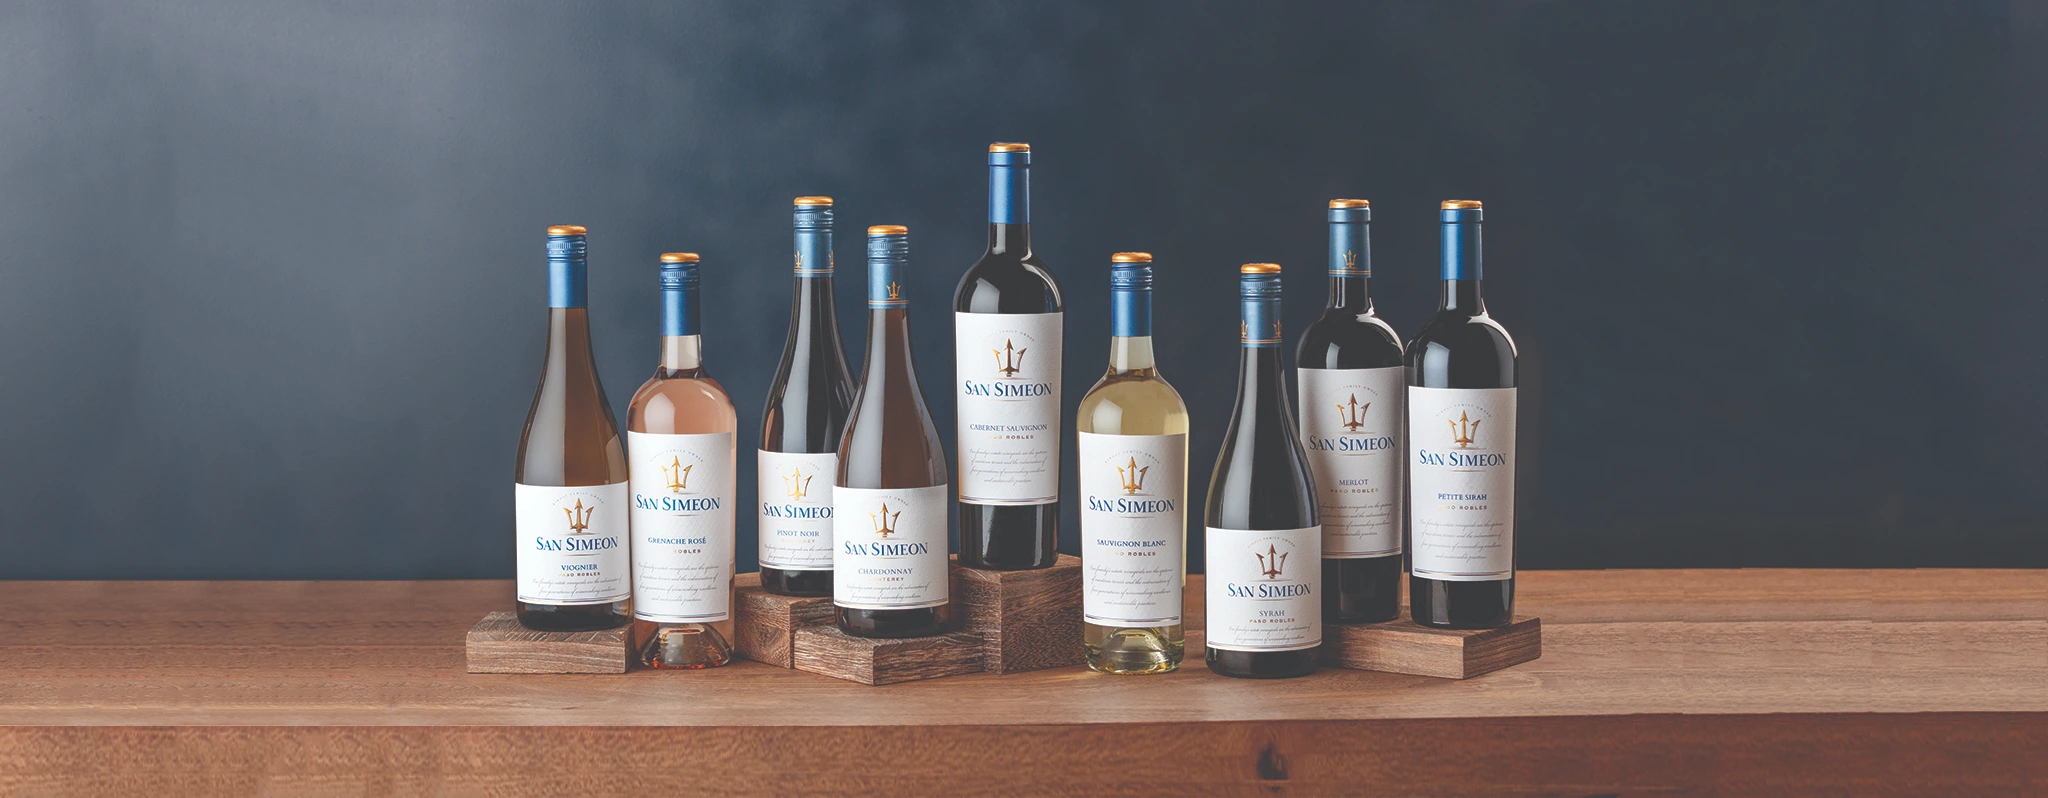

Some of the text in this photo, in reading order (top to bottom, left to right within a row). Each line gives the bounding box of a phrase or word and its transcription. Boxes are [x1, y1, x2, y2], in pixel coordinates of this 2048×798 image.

[965, 379, 1052, 397] SAN SIMEON
[969, 423, 1048, 432] CABERNET SAUVIGNON
[1309, 435, 1395, 451] SAN SIMEON
[1419, 449, 1506, 467] SAN SIMEON
[636, 493, 720, 511] SAN SIMEON
[1089, 495, 1175, 513] SAN SIMEON
[763, 502, 834, 519] SAN SIMEO
[647, 536, 707, 545] GRENACHE ROSÉ
[777, 529, 797, 537] PINOT
[536, 536, 618, 551] SAN SIMEON
[845, 540, 867, 556] SAN
[871, 542, 928, 556] SIMEON
[1097, 539, 1140, 547] SAUVIGNON
[1227, 583, 1311, 598] SAN SIMEON
